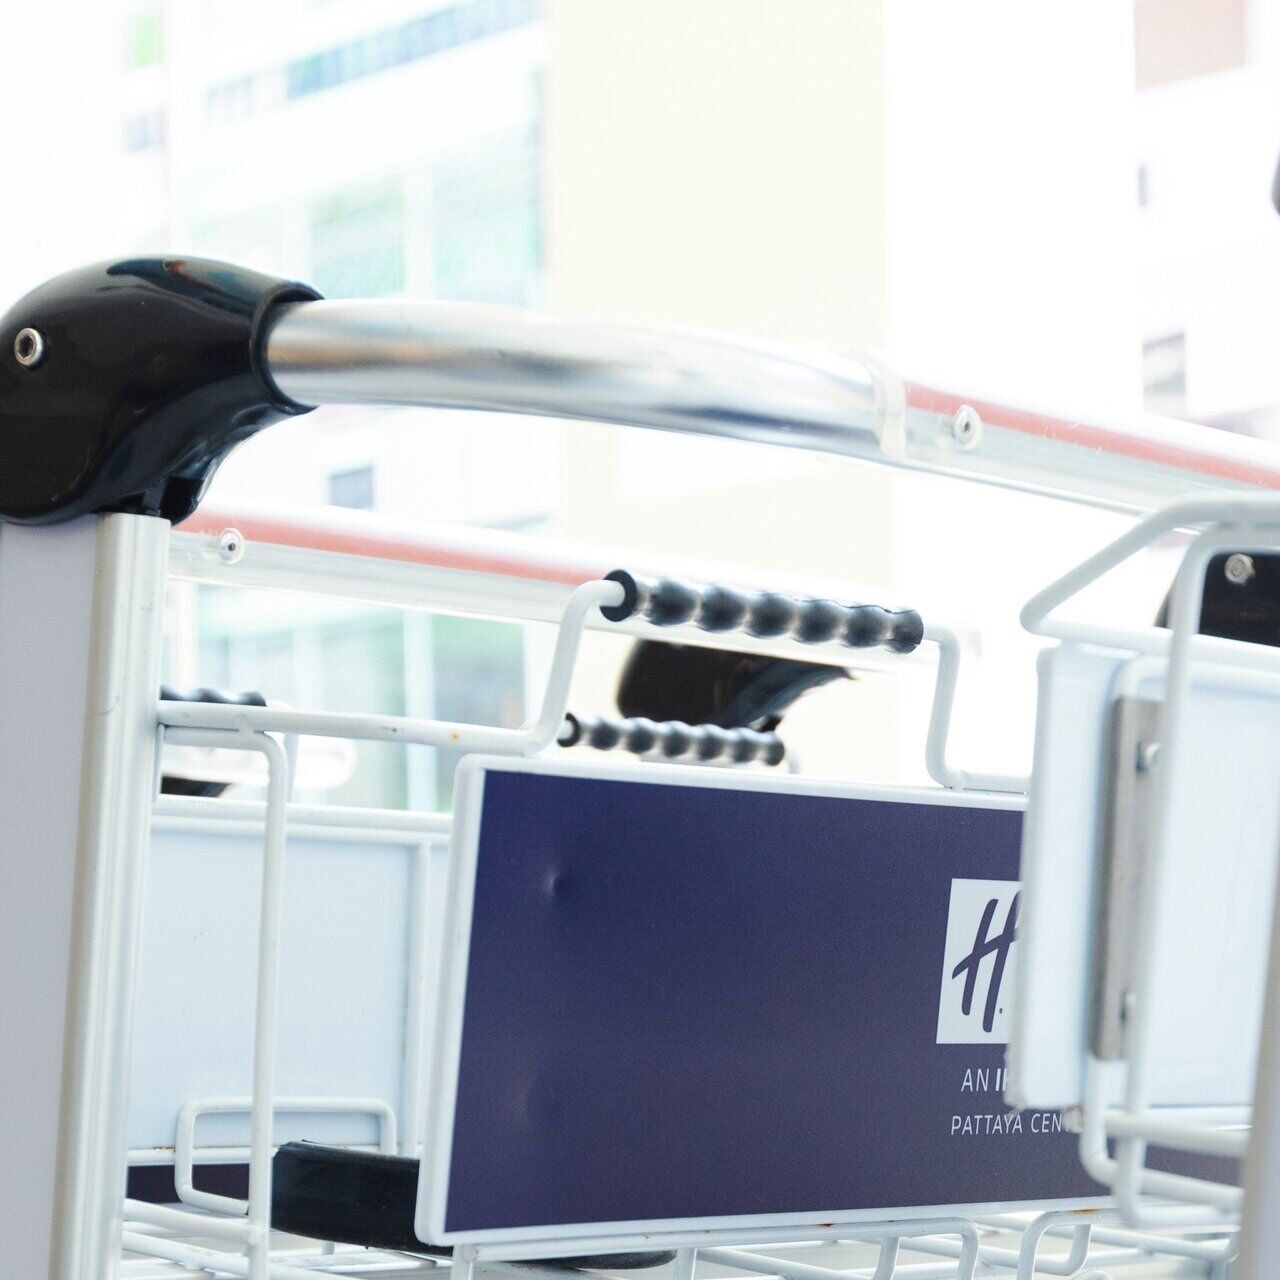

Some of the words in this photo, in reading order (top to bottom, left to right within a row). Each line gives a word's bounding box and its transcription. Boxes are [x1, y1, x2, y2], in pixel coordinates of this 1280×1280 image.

[960, 1068, 990, 1093] AN
[950, 1110, 1023, 1136] PATTAYA
[1030, 1112, 1068, 1134] CEN
